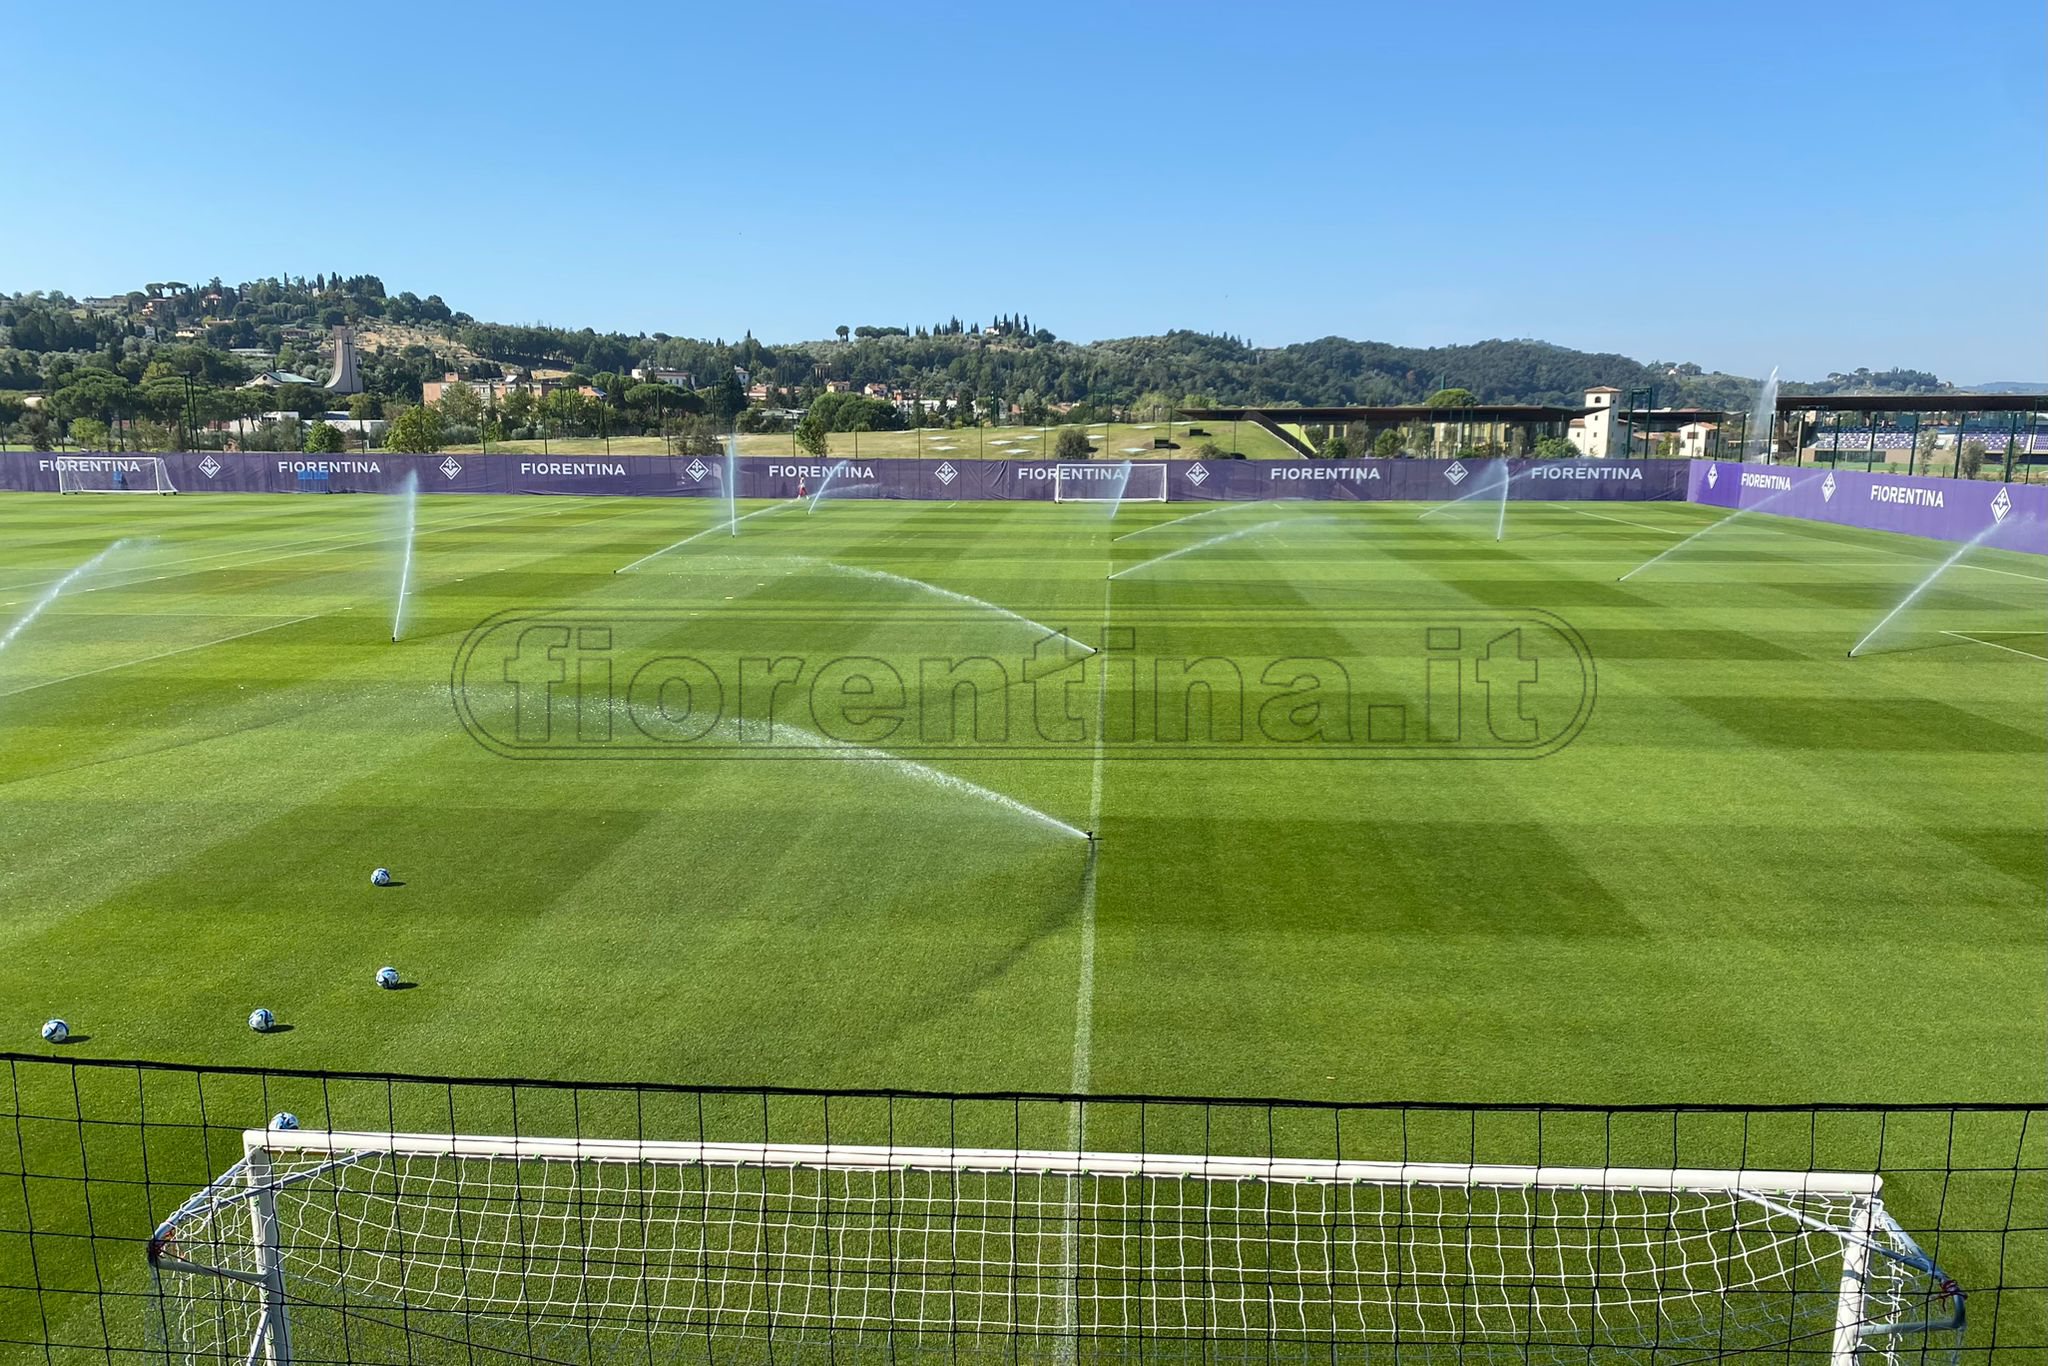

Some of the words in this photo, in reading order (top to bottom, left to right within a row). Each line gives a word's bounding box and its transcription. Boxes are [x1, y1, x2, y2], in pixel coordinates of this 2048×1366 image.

[39, 460, 141, 472] FIORENTINA
[278, 461, 380, 473] FIORENTINA
[520, 462, 626, 475] FIORENTINA
[769, 465, 874, 478] FIORENTINA
[1018, 468, 1125, 480] FIORENTINA
[1271, 467, 1380, 480] FIORENTINA
[1531, 467, 1642, 480] FIORENTINA
[1741, 472, 1792, 490] FIORENTINA
[1870, 484, 1944, 507] FIORENTINA
